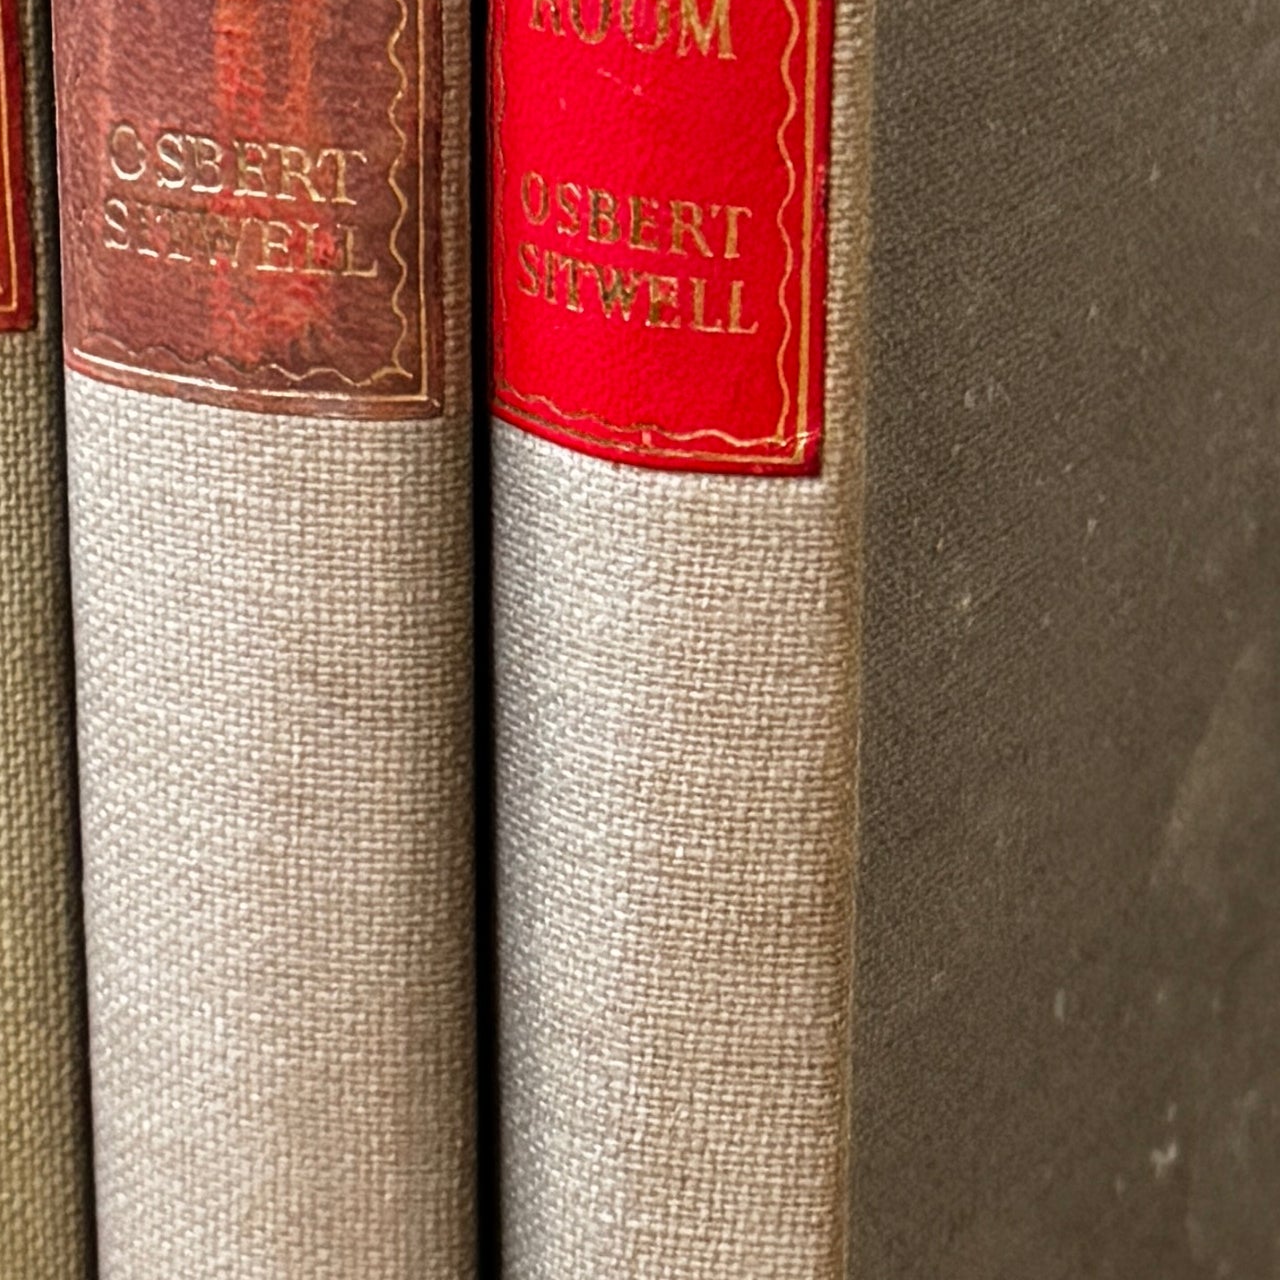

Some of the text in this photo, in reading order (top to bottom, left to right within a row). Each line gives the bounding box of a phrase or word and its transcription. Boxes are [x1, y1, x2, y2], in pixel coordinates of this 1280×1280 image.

[110, 124, 368, 206] OSBERT
[103, 198, 378, 278] SITWELL
[521, 170, 753, 260] OSBERT
[516, 242, 760, 335] SITWELL
